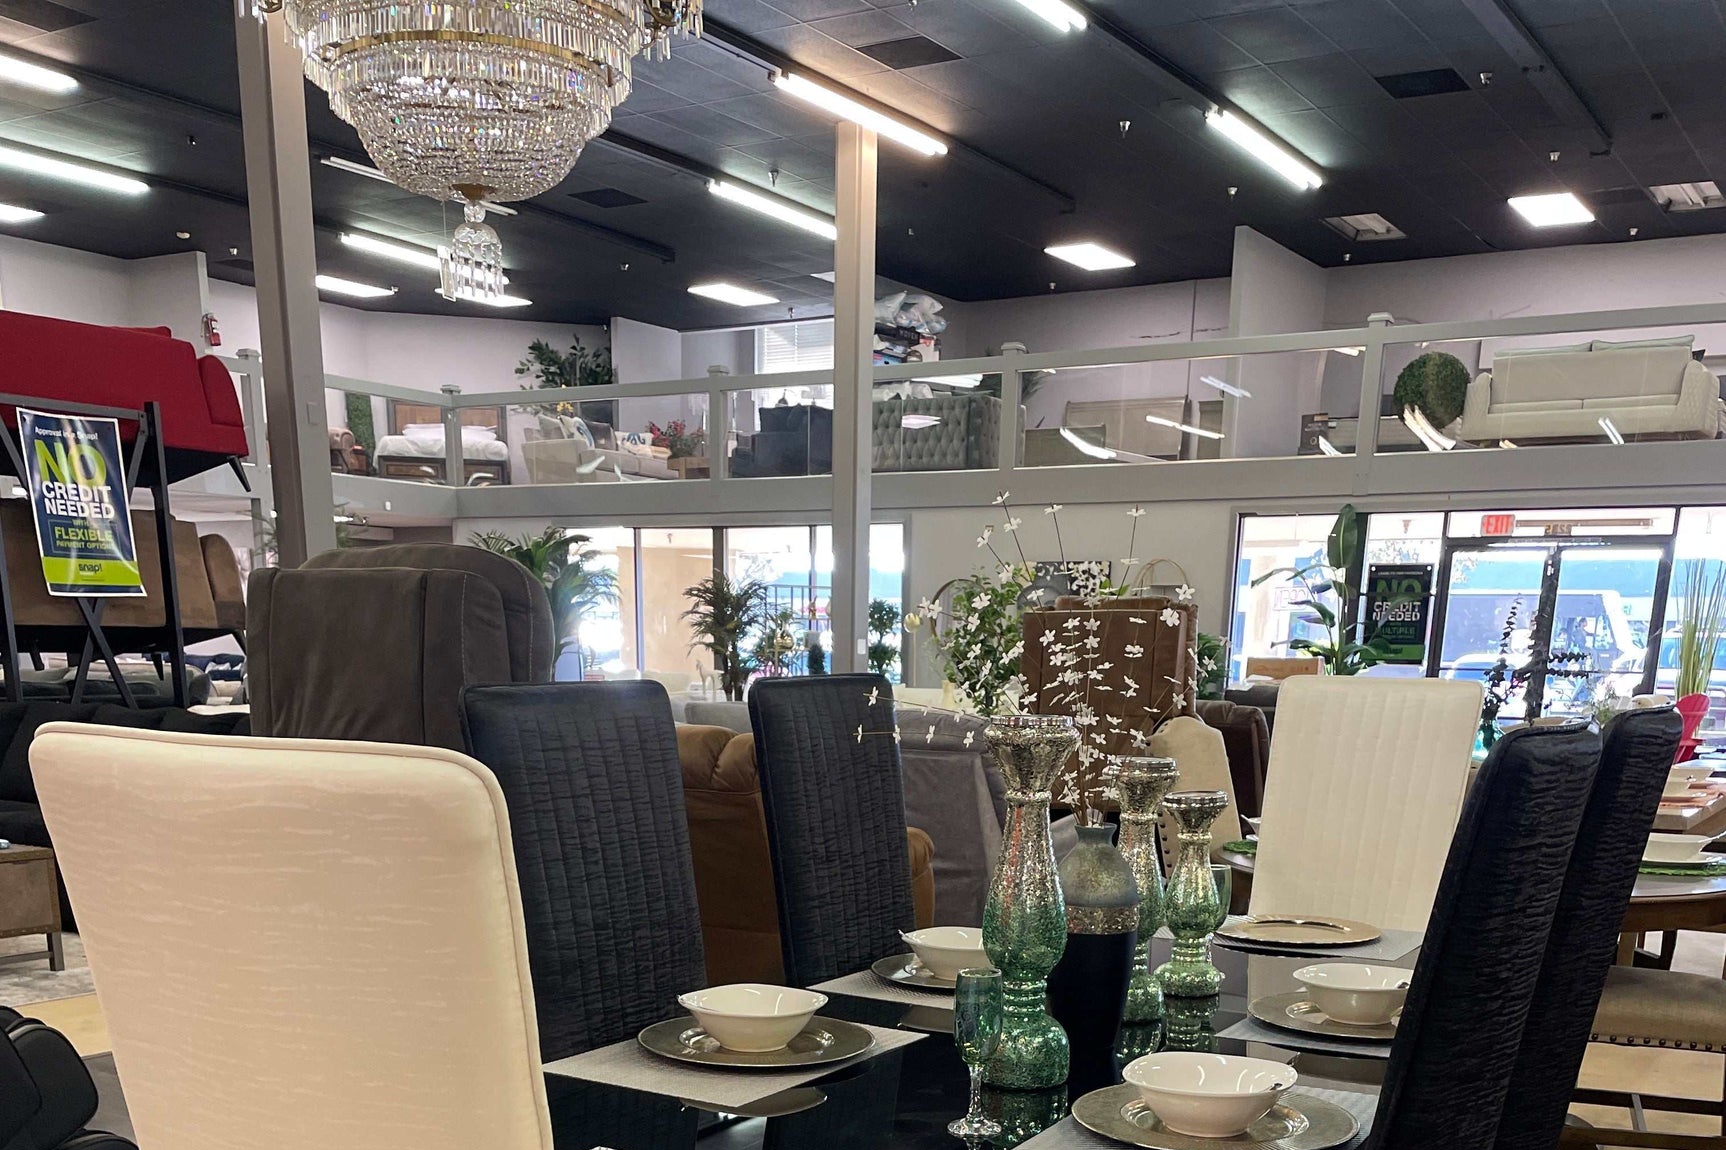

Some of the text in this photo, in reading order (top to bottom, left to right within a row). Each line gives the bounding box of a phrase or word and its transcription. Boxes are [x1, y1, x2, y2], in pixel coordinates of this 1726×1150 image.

[34, 439, 107, 488] NO
[42, 481, 112, 503] CREDIT
[45, 498, 115, 519] NEEDED
[54, 526, 113, 542] FLEXIBLE
[1485, 514, 1511, 534] EXIT
[78, 563, 102, 575] snap!
[1376, 578, 1422, 602] NO
[1372, 611, 1420, 621] NEDED
[1373, 601, 1421, 613] CRDIT
